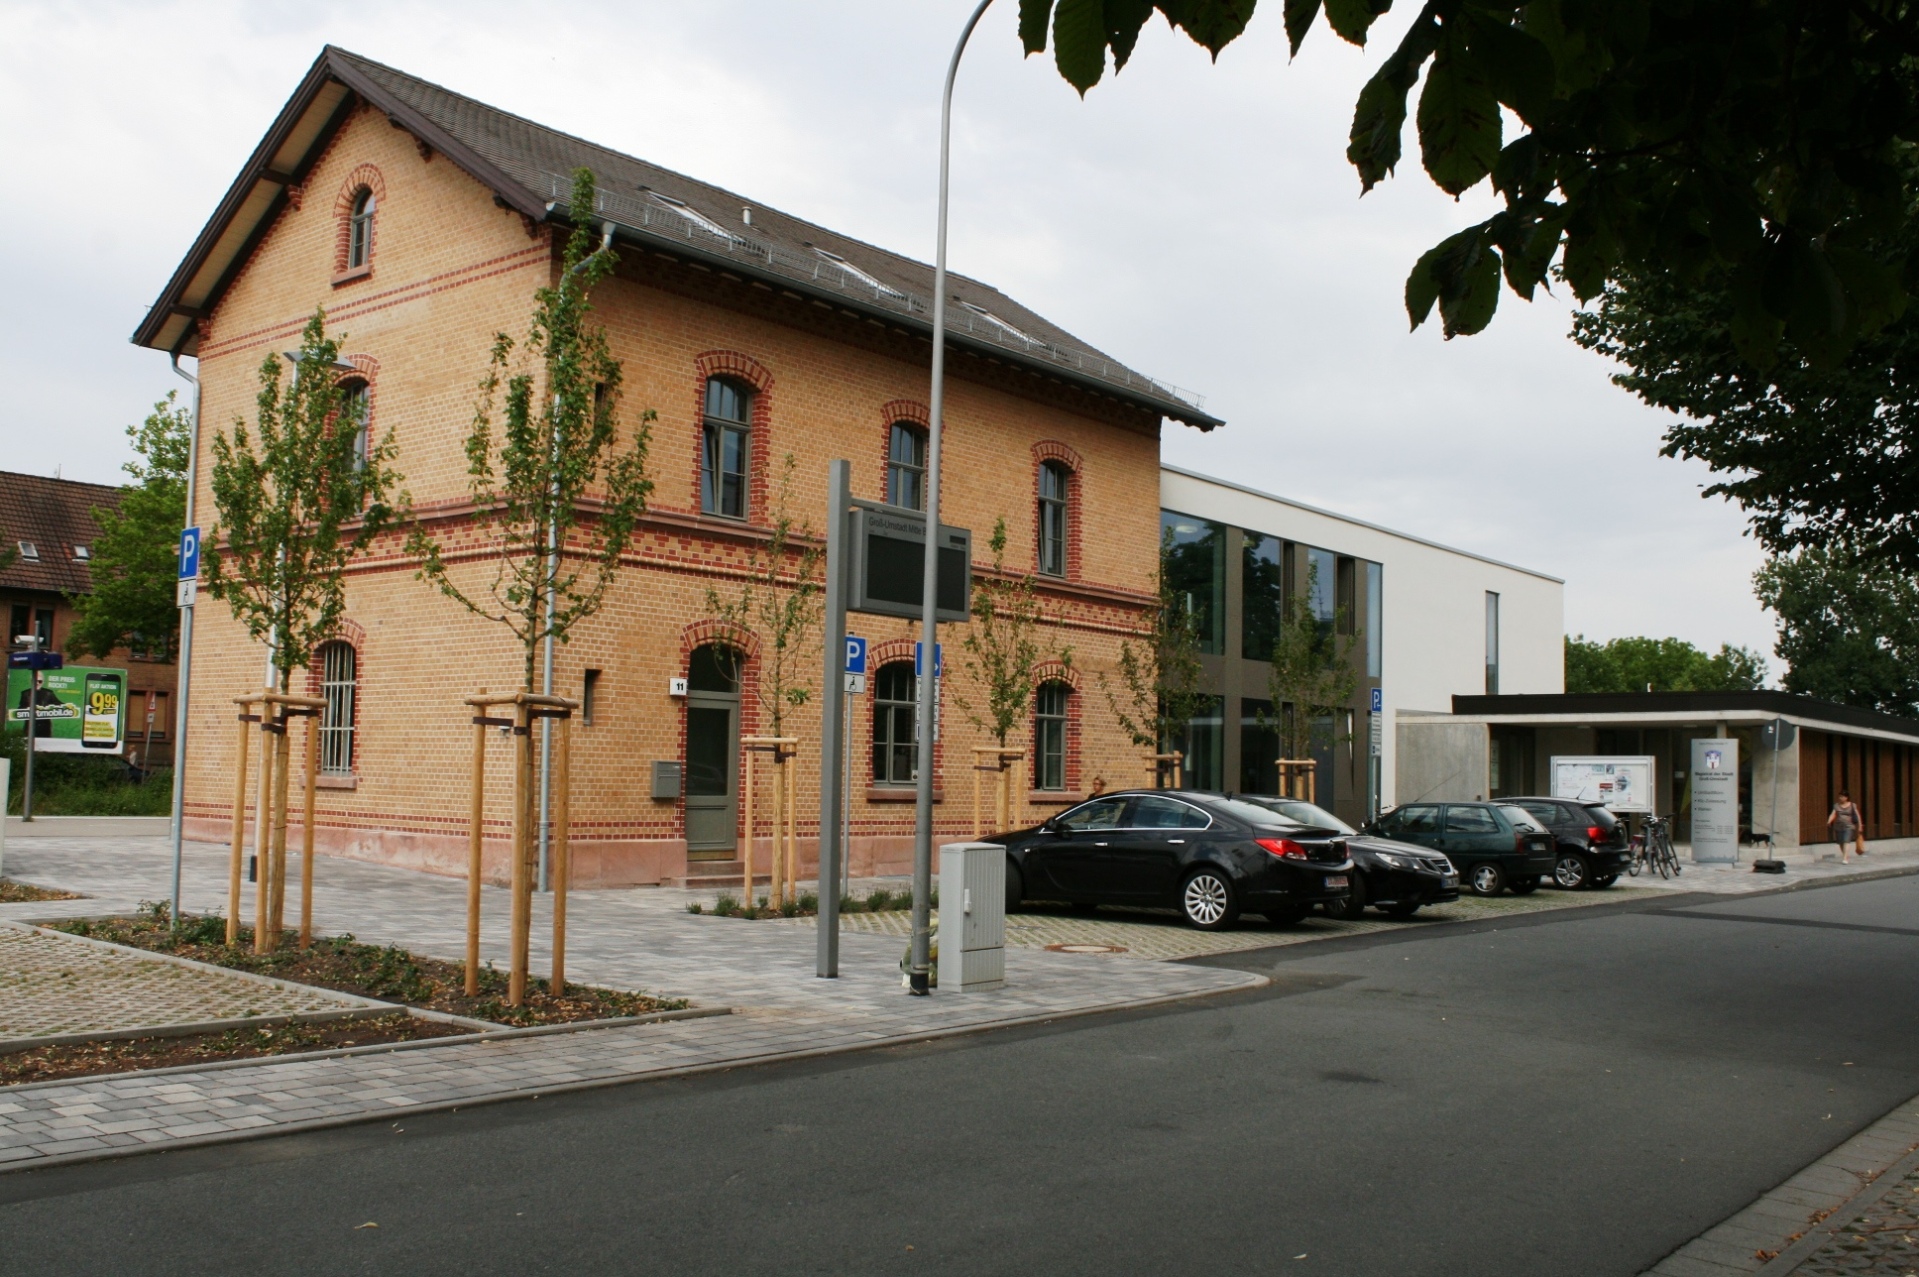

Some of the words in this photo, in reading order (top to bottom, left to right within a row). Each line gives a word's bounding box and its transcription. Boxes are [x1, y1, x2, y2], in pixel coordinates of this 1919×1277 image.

[868, 516, 908, 532] Groß-Umstadt
[908, 524, 922, 535] Mitte
[182, 534, 195, 572] P
[846, 641, 861, 668] P
[676, 682, 684, 691] 11
[1373, 691, 1380, 709] P
[16, 707, 74, 718] smtmobil.de
